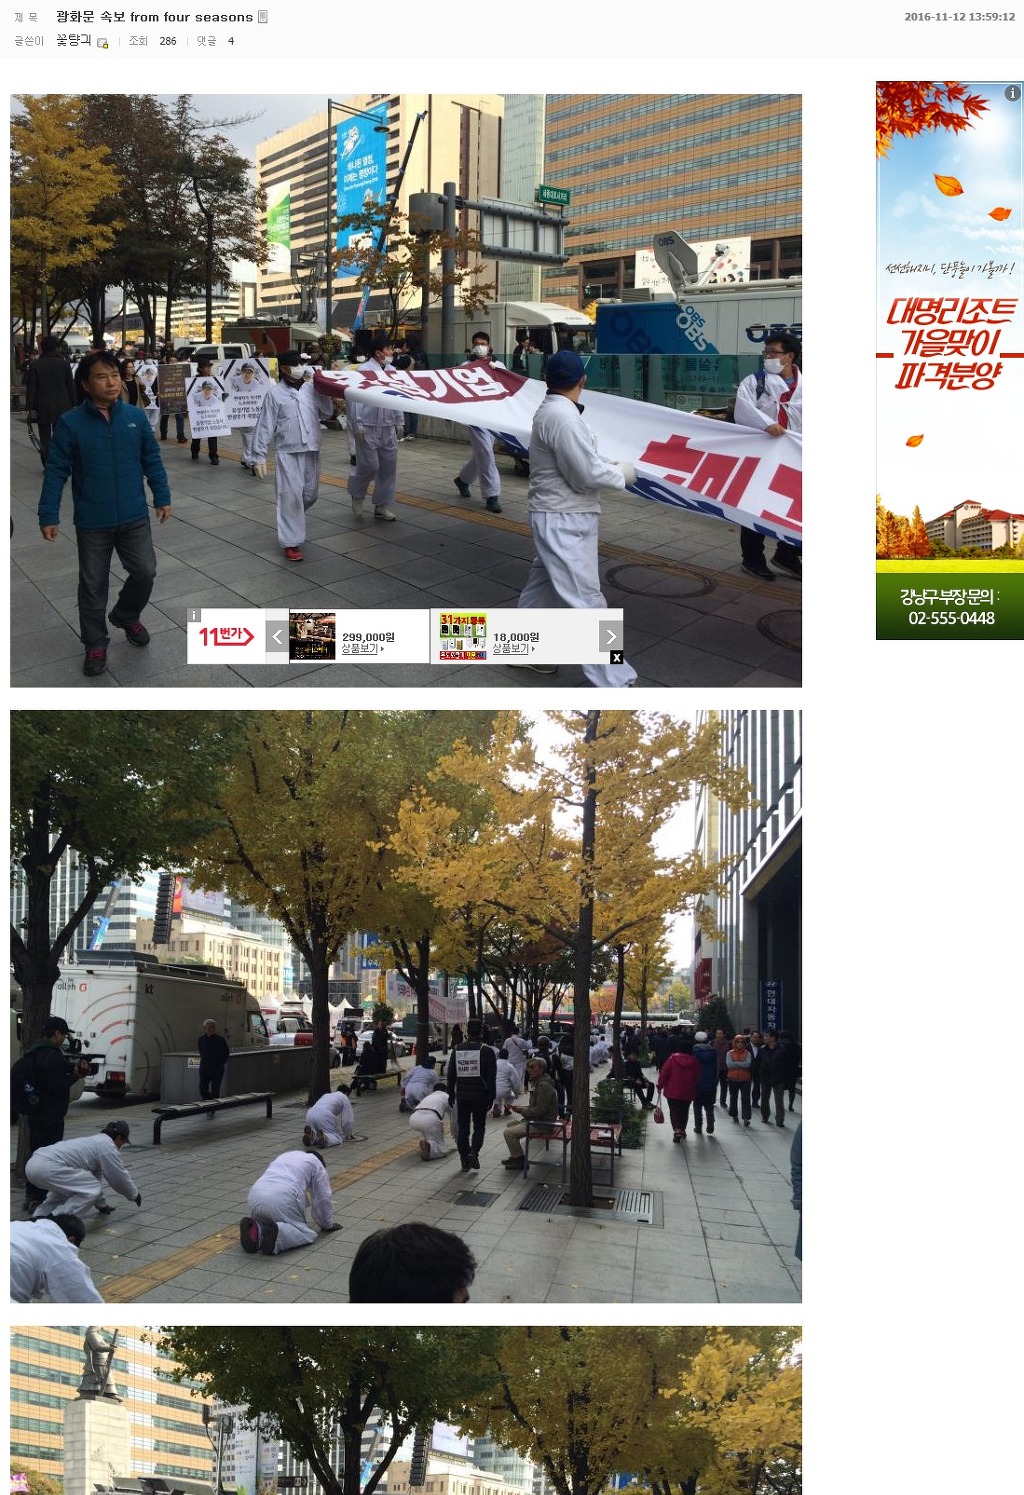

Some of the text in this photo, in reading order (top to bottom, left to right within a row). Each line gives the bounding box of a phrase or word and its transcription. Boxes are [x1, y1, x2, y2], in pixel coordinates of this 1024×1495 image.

[56, 10, 254, 24] 광화문 속보 from four seasons
[904, 12, 1016, 22] 2016-11-12 13:59:12
[14, 35, 44, 47] 글쓴이
[128, 35, 177, 47] 조회 286
[196, 35, 235, 47] 댓글 4
[658, 236, 675, 247] OBS
[686, 305, 706, 329] OBS
[676, 311, 707, 351] OBS
[144, 982, 155, 995] kt
